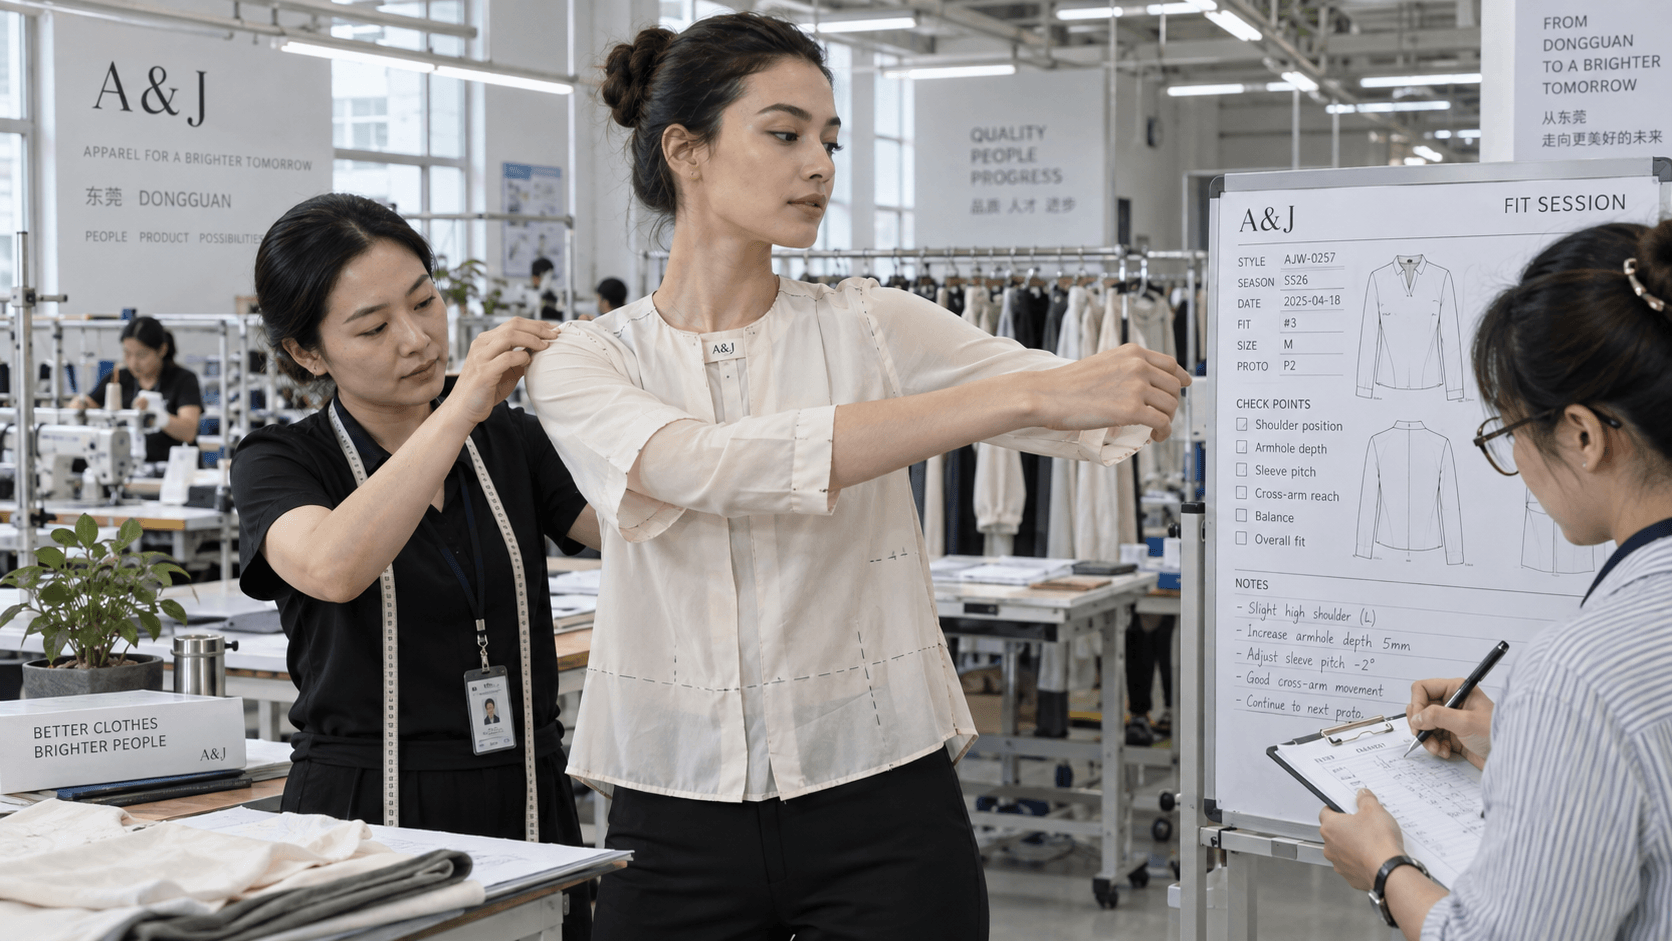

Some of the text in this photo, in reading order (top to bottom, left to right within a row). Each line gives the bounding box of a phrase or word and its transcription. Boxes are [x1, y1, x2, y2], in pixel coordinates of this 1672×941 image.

[1544, 15, 1588, 29] FROM
[1543, 34, 1634, 52] DONGGUAN
[1543, 55, 1661, 73] TO A BRIGHTER
[1543, 79, 1637, 95] TOMORROW
[1542, 110, 1587, 125] 从东莞
[970, 124, 1047, 143] QUALITY
[1542, 129, 1663, 148] 走向更美好的未来
[83, 145, 313, 172] APPAREL FOR A BRIGHTER TOMORROW
[971, 147, 1036, 165] PEOPLE
[971, 168, 1063, 186] PROGRESS
[85, 186, 232, 209] 东莞 DONGGUAN
[1504, 193, 1626, 214] FIT SESSION
[1239, 205, 1295, 234] A&J
[85, 231, 127, 242] PEOPLE
[140, 232, 189, 243] PRODUCT
[1238, 251, 1336, 268] STYLE AJW-0257
[1238, 274, 1308, 288] SEASON SS26
[1237, 295, 1341, 309] DATE 2025-04-18
[1237, 317, 1297, 330] FIT #3
[712, 342, 734, 354] A&J
[1237, 339, 1293, 351] SIZE M
[1237, 360, 1296, 372] PROTO P2
[1236, 398, 1311, 410] CHECK POINTS
[1255, 419, 1343, 434] Shoulder position
[1256, 443, 1327, 457] Armhole depth
[1255, 465, 1316, 480] Sleeve pitch
[1255, 488, 1340, 502] Cross-arm reach
[1255, 511, 1294, 524] Balance
[1255, 533, 1305, 548] Overall fit
[1235, 578, 1269, 591] NOTES
[1249, 602, 1277, 620] Slight
[1285, 604, 1305, 624] high
[1314, 606, 1351, 621] shoulder
[1360, 608, 1375, 627] (L)
[1248, 624, 1287, 640] Increase
[1296, 630, 1333, 644] armhole
[1343, 632, 1372, 652] depth
[1383, 638, 1410, 651] 5mm
[1247, 647, 1278, 666] Adjust
[1286, 651, 1312, 665] sleeve
[1321, 656, 1345, 673] pitch
[1247, 671, 1270, 685] Good
[1278, 678, 1327, 690] cross-arm
[1335, 685, 1383, 696] movement
[1247, 694, 1285, 713] Continue
[1292, 700, 1300, 712] to
[1308, 704, 1329, 715] next
[1335, 707, 1365, 722] proto.
[34, 717, 158, 739] BETTER CLOTHES
[34, 735, 166, 758] BRIGHTER PEOPLE
[200, 747, 227, 762] A&J
